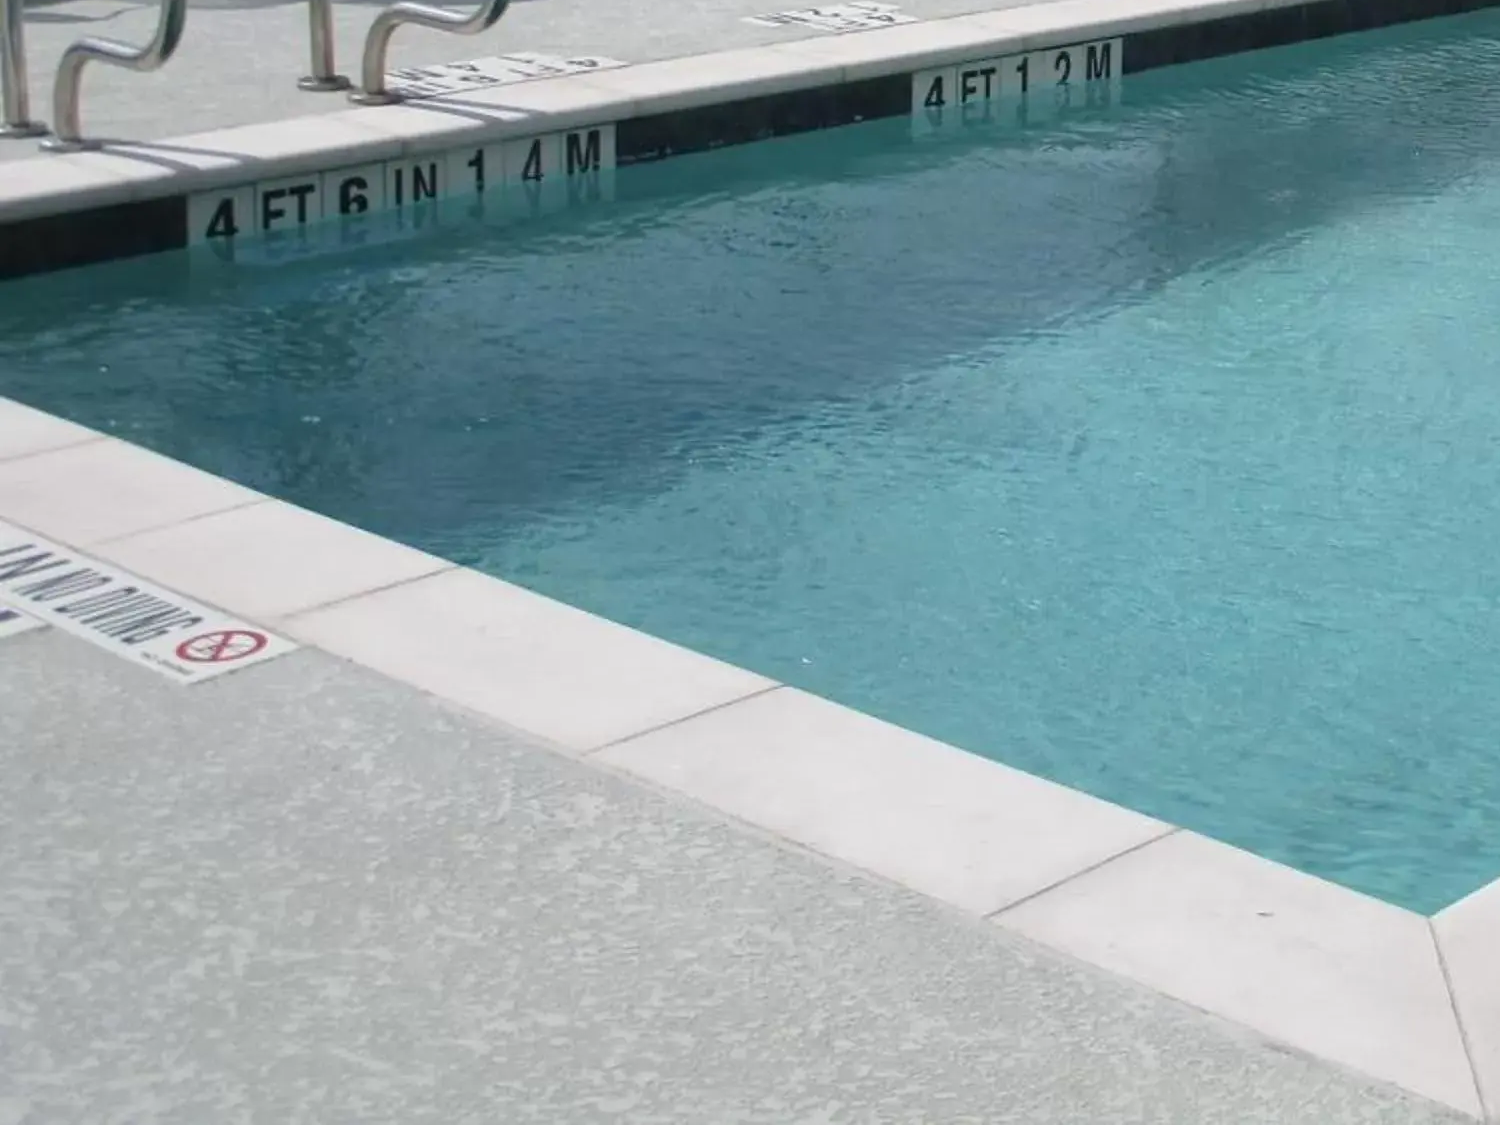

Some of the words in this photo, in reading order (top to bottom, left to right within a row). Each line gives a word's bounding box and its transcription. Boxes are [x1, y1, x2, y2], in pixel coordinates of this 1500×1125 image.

[924, 75, 946, 107] 4
[960, 66, 997, 104] FT
[1016, 56, 1029, 93] 1
[1085, 42, 1112, 81] M
[205, 197, 239, 239] 4
[262, 183, 316, 230] FT
[338, 175, 369, 214] 6
[394, 161, 437, 206] IN
[467, 148, 485, 193] 1
[520, 138, 545, 183] 4
[566, 129, 601, 176] M
